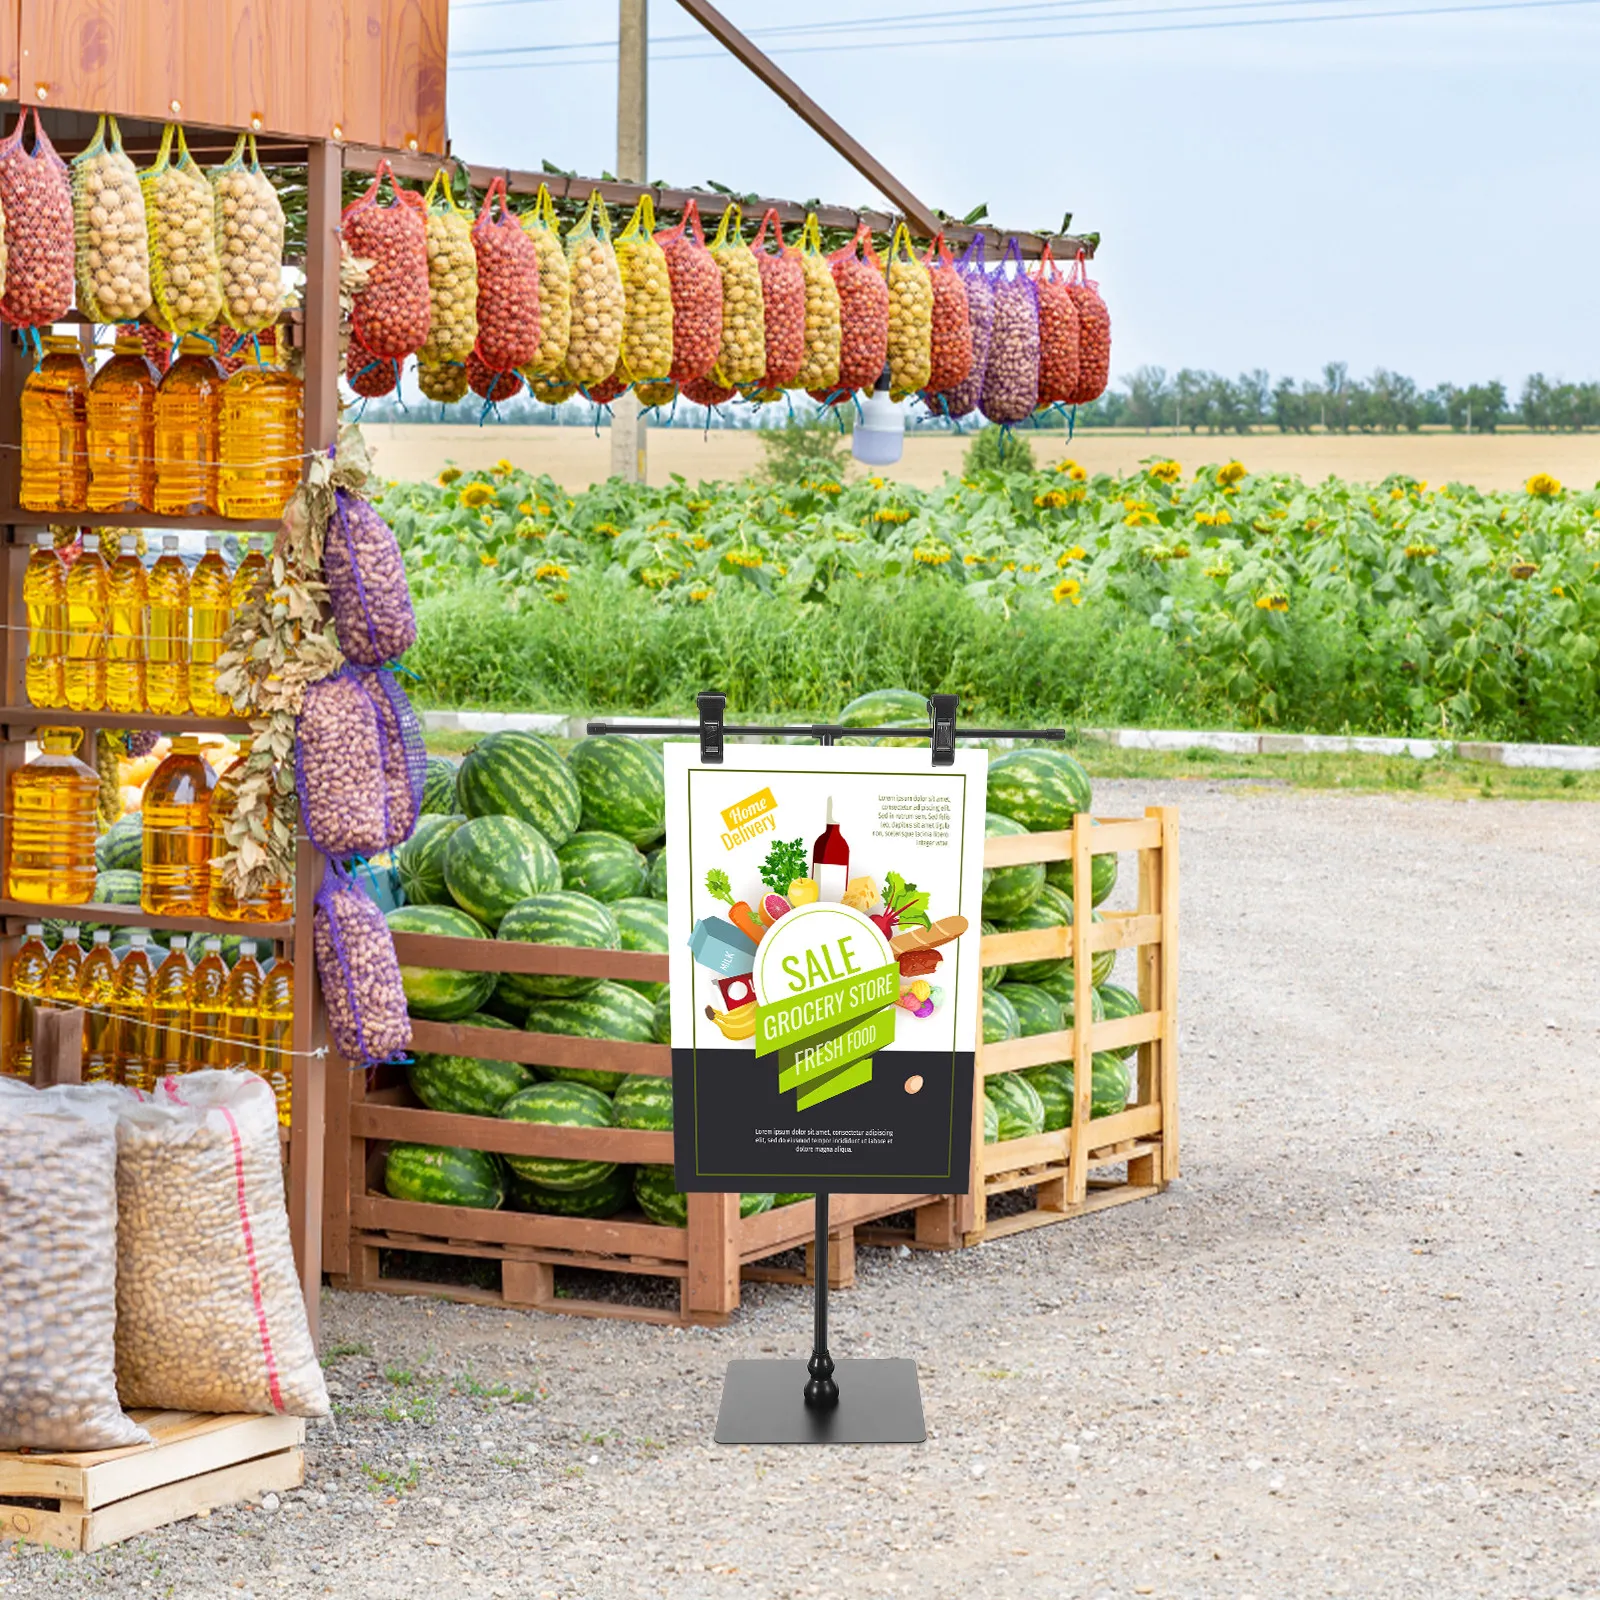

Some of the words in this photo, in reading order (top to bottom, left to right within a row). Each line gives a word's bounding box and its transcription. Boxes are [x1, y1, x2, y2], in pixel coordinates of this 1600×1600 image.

[729, 798, 767, 825] Home
[720, 813, 776, 851] Delivery
[719, 950, 735, 971] MILK
[781, 935, 862, 992] SALE
[763, 990, 845, 1041] GROCERY
[849, 973, 893, 1008] STORE
[794, 1036, 843, 1076] FRESH
[847, 1025, 877, 1053] FOOD
[755, 1128, 773, 1136] Lorem
[773, 1128, 790, 1137] ipsum
[791, 1128, 806, 1136] dolor
[807, 1128, 815, 1136] sit
[815, 1129, 831, 1137] amet,
[865, 1129, 894, 1137] adipiscing
[755, 1136, 766, 1144] elit,
[795, 1145, 813, 1153] dolore
[814, 1146, 833, 1154] magna
[834, 1145, 853, 1154] aliqua.
